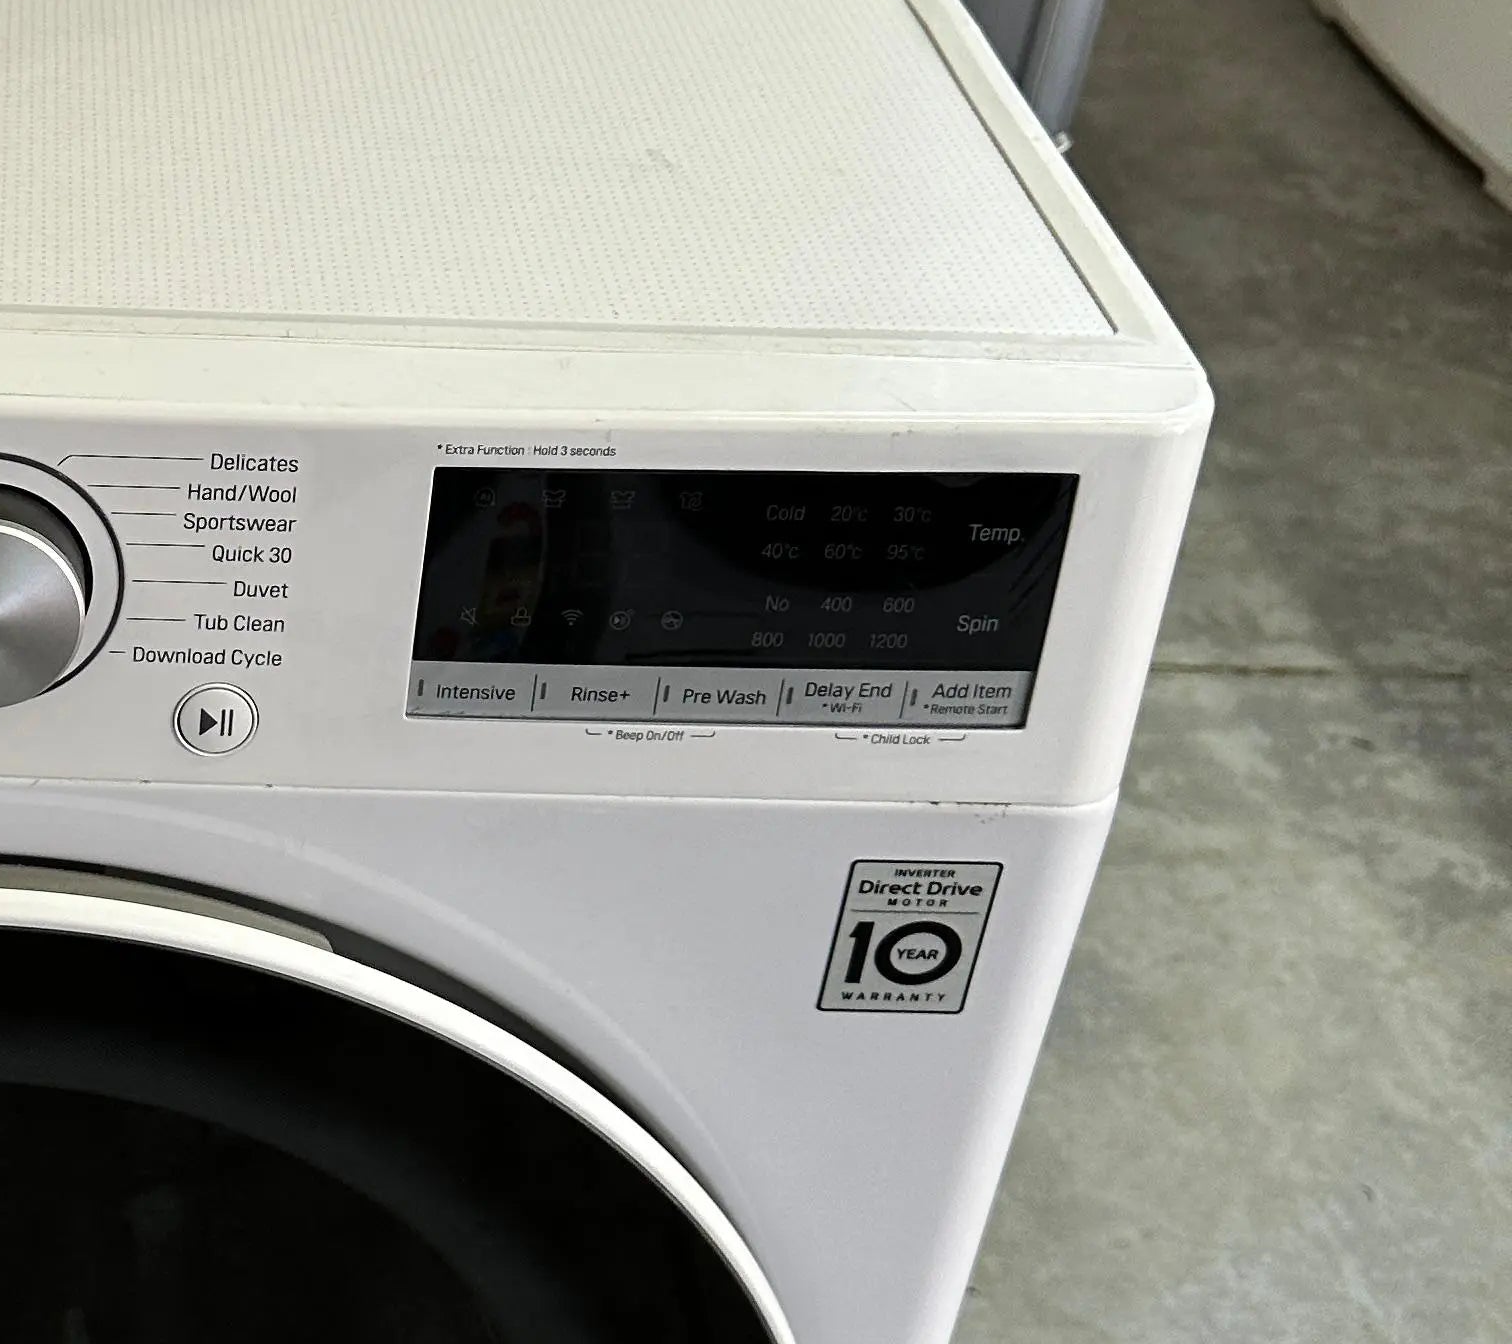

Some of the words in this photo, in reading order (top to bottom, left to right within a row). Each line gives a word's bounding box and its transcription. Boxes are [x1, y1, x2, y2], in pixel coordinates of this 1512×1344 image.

[445, 444, 474, 456] Extra
[477, 444, 525, 456] Function
[533, 445, 558, 456] Hold
[560, 446, 568, 456] 3
[570, 446, 617, 457] seconds
[210, 453, 299, 473] Delicates
[188, 483, 297, 503] Hand/Wool
[766, 505, 806, 522] Cold
[183, 512, 297, 533] Sportswear
[212, 544, 264, 563] Quick
[269, 547, 292, 564] 30
[233, 581, 288, 598] Duvet
[764, 595, 790, 612] No
[821, 596, 853, 613] 400
[882, 597, 915, 614] 600
[194, 613, 228, 631] Tub
[233, 615, 285, 633] Clean
[956, 614, 1000, 635] Spin
[751, 631, 784, 648] 800
[808, 632, 846, 648] 1000
[869, 632, 908, 649] 1200
[132, 646, 226, 665] Download
[231, 649, 282, 669] Cycle
[436, 684, 516, 702] Intensive
[570, 686, 631, 702] Rinse+
[682, 688, 711, 705] Pre
[716, 689, 767, 706] Wash
[804, 681, 853, 702] Delay
[858, 683, 893, 699] End
[931, 683, 969, 699] Add
[972, 683, 1012, 700] Item
[615, 729, 645, 742] Beep
[871, 733, 900, 745] Child
[902, 734, 931, 746] Lock
[894, 868, 956, 878] INVERTER
[858, 879, 921, 895] Direct
[926, 881, 983, 896] Drive
[887, 898, 949, 907] MOTOR
[844, 921, 963, 986] 10
[896, 948, 939, 960] YEAR
[841, 991, 946, 1002] WARRANTY
